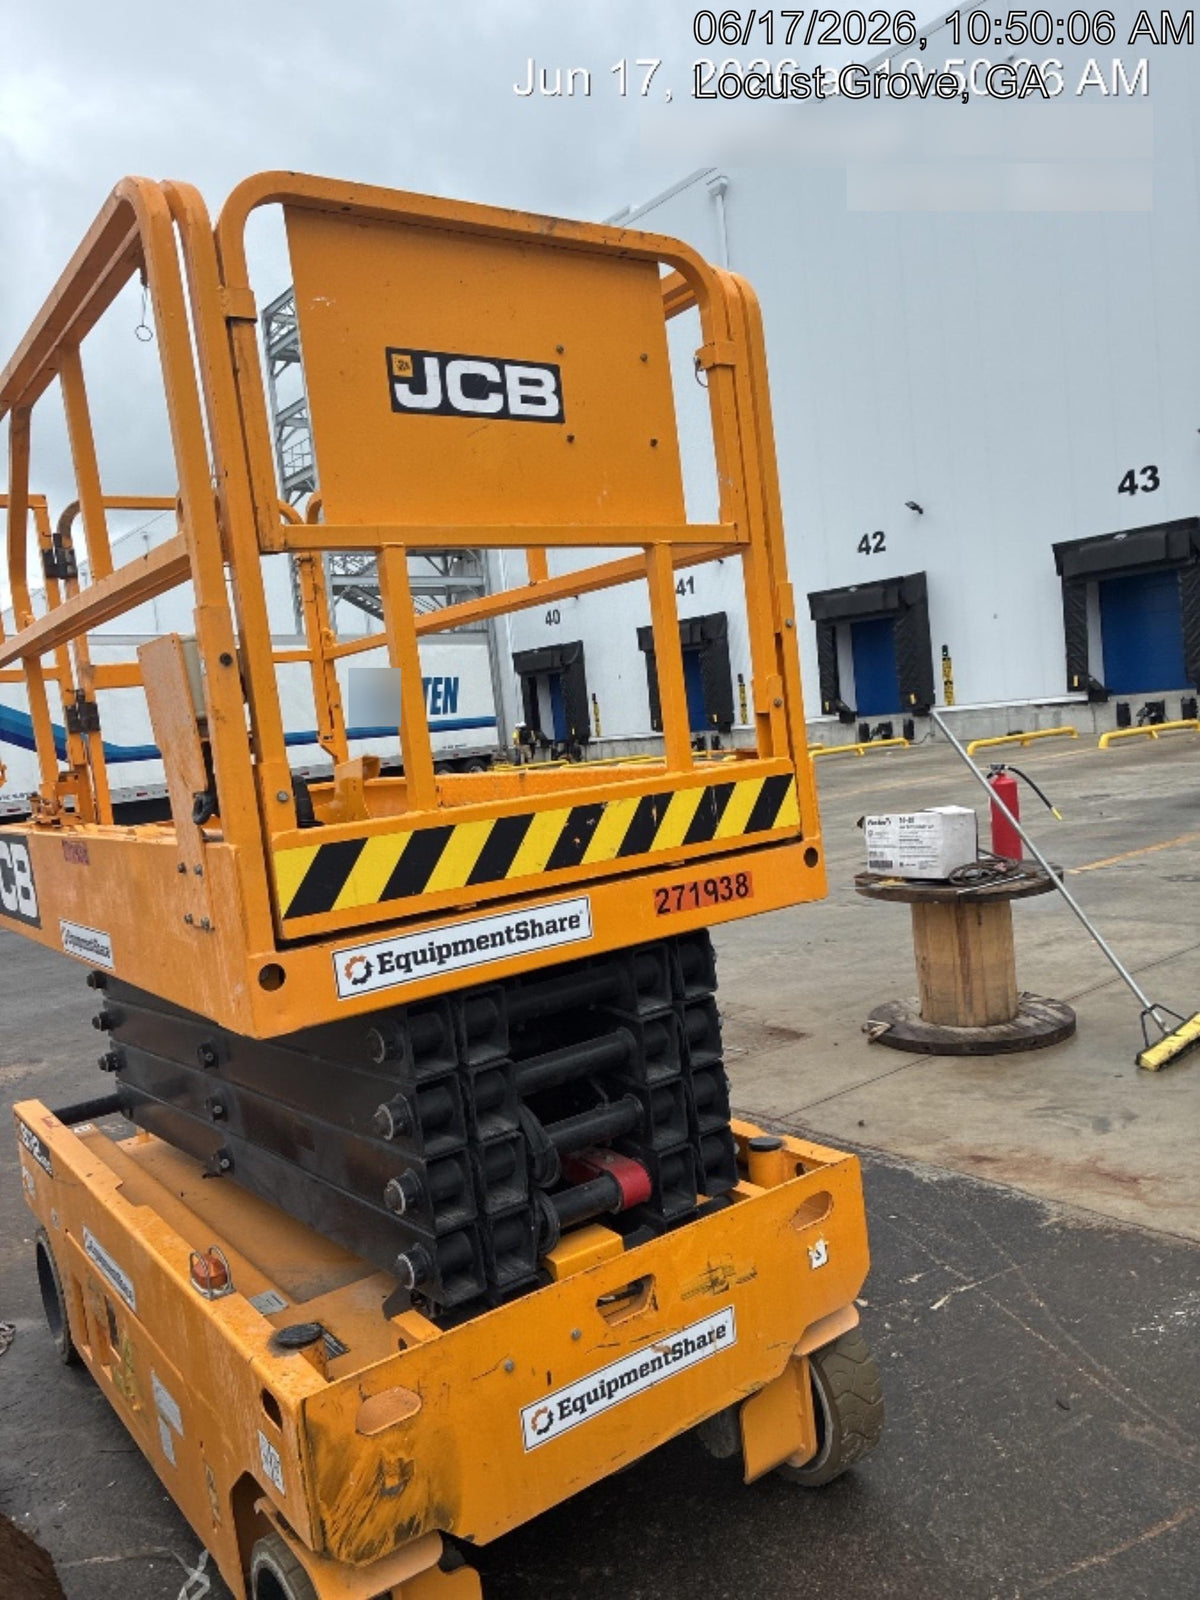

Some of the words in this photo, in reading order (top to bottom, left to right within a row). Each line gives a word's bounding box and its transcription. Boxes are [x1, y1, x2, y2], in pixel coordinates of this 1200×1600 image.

[393, 356, 560, 417] JCB
[1117, 465, 1160, 496] 43
[857, 531, 887, 556] 42
[676, 575, 695, 597] 41
[545, 609, 561, 626] 40
[655, 872, 749, 915] 271938
[377, 911, 580, 975] EquipmentShare
[556, 1321, 727, 1421] EquipmentShare
